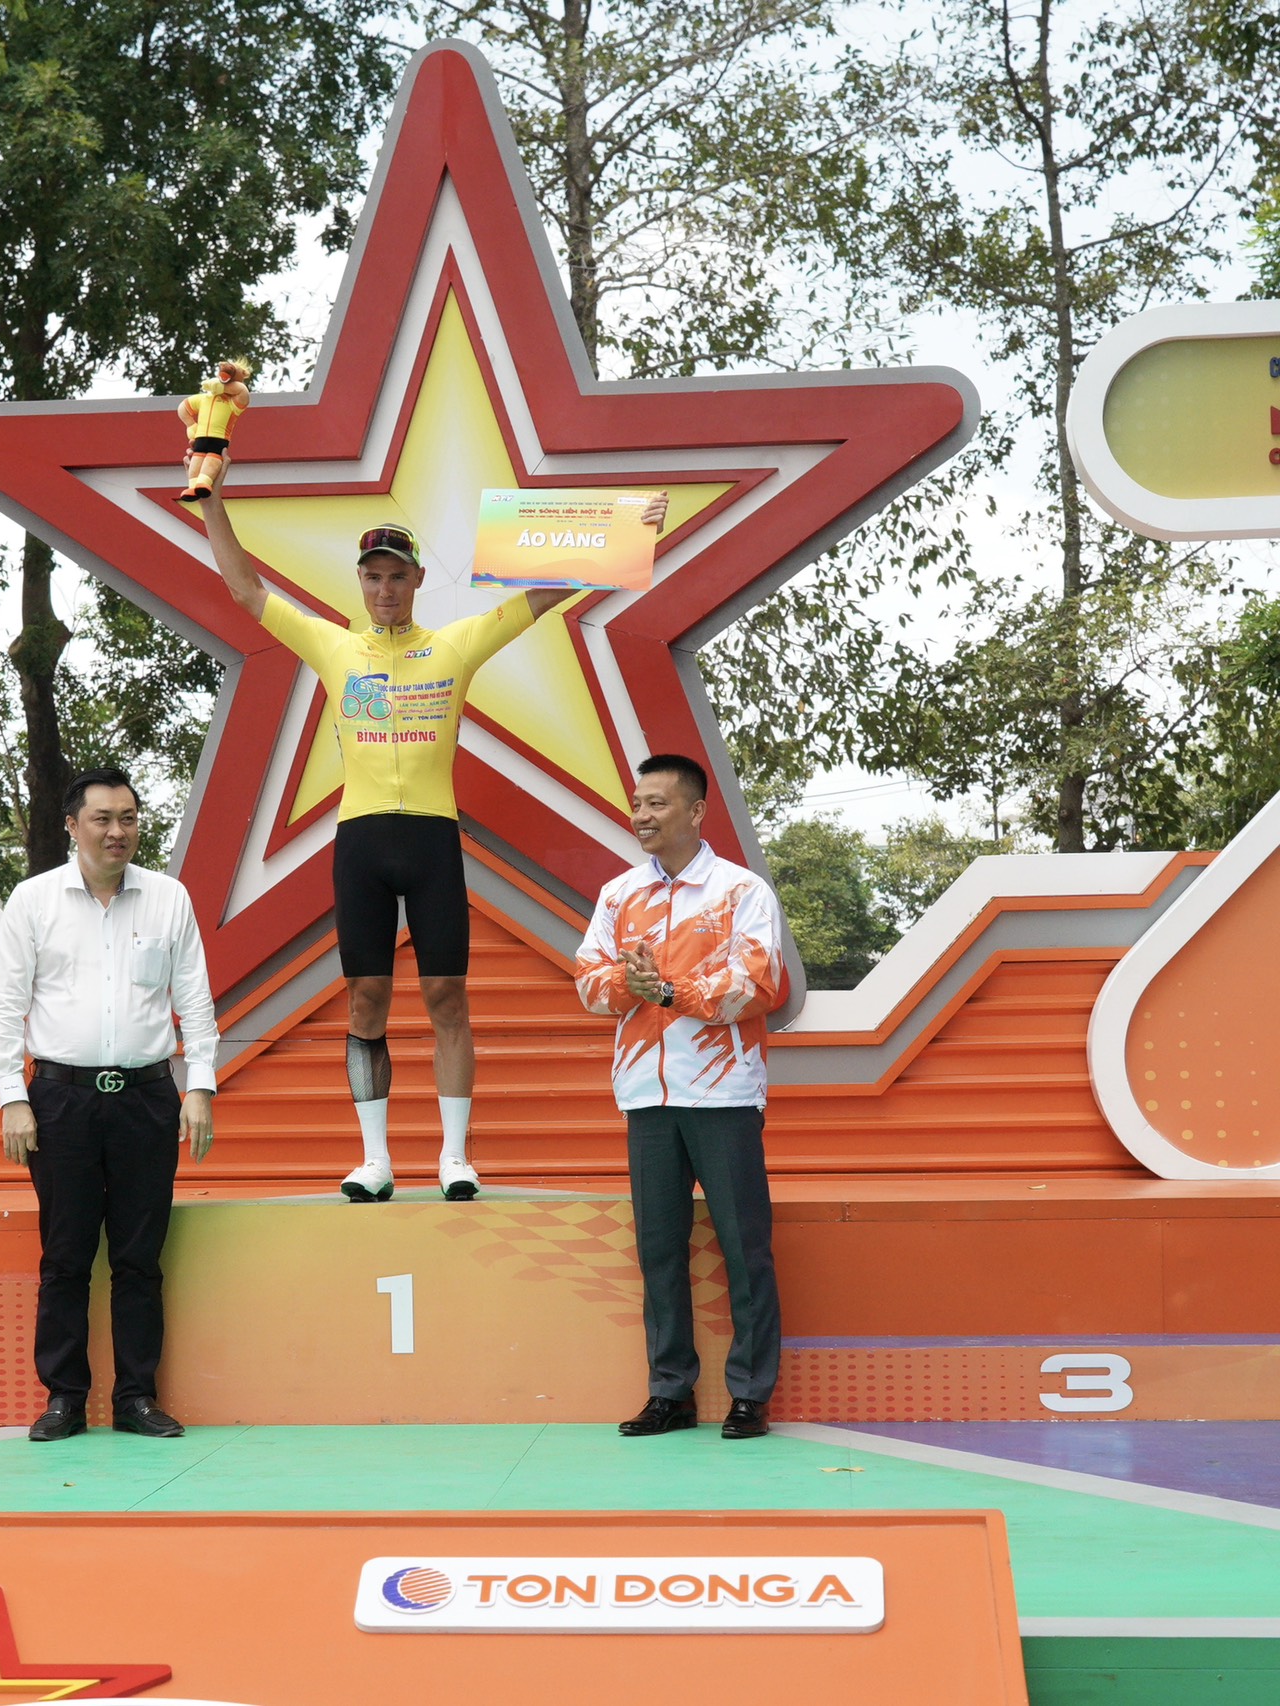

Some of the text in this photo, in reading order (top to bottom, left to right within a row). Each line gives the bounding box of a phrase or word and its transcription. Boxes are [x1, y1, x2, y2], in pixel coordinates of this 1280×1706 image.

[517, 529, 606, 548] ÁO VÀNG
[405, 647, 432, 659] HTV
[357, 729, 436, 743] BÌNH DƯƠNG
[376, 1273, 414, 1354] 1
[1039, 1353, 1134, 1413] 3
[468, 1574, 855, 1603] TON DONG A
